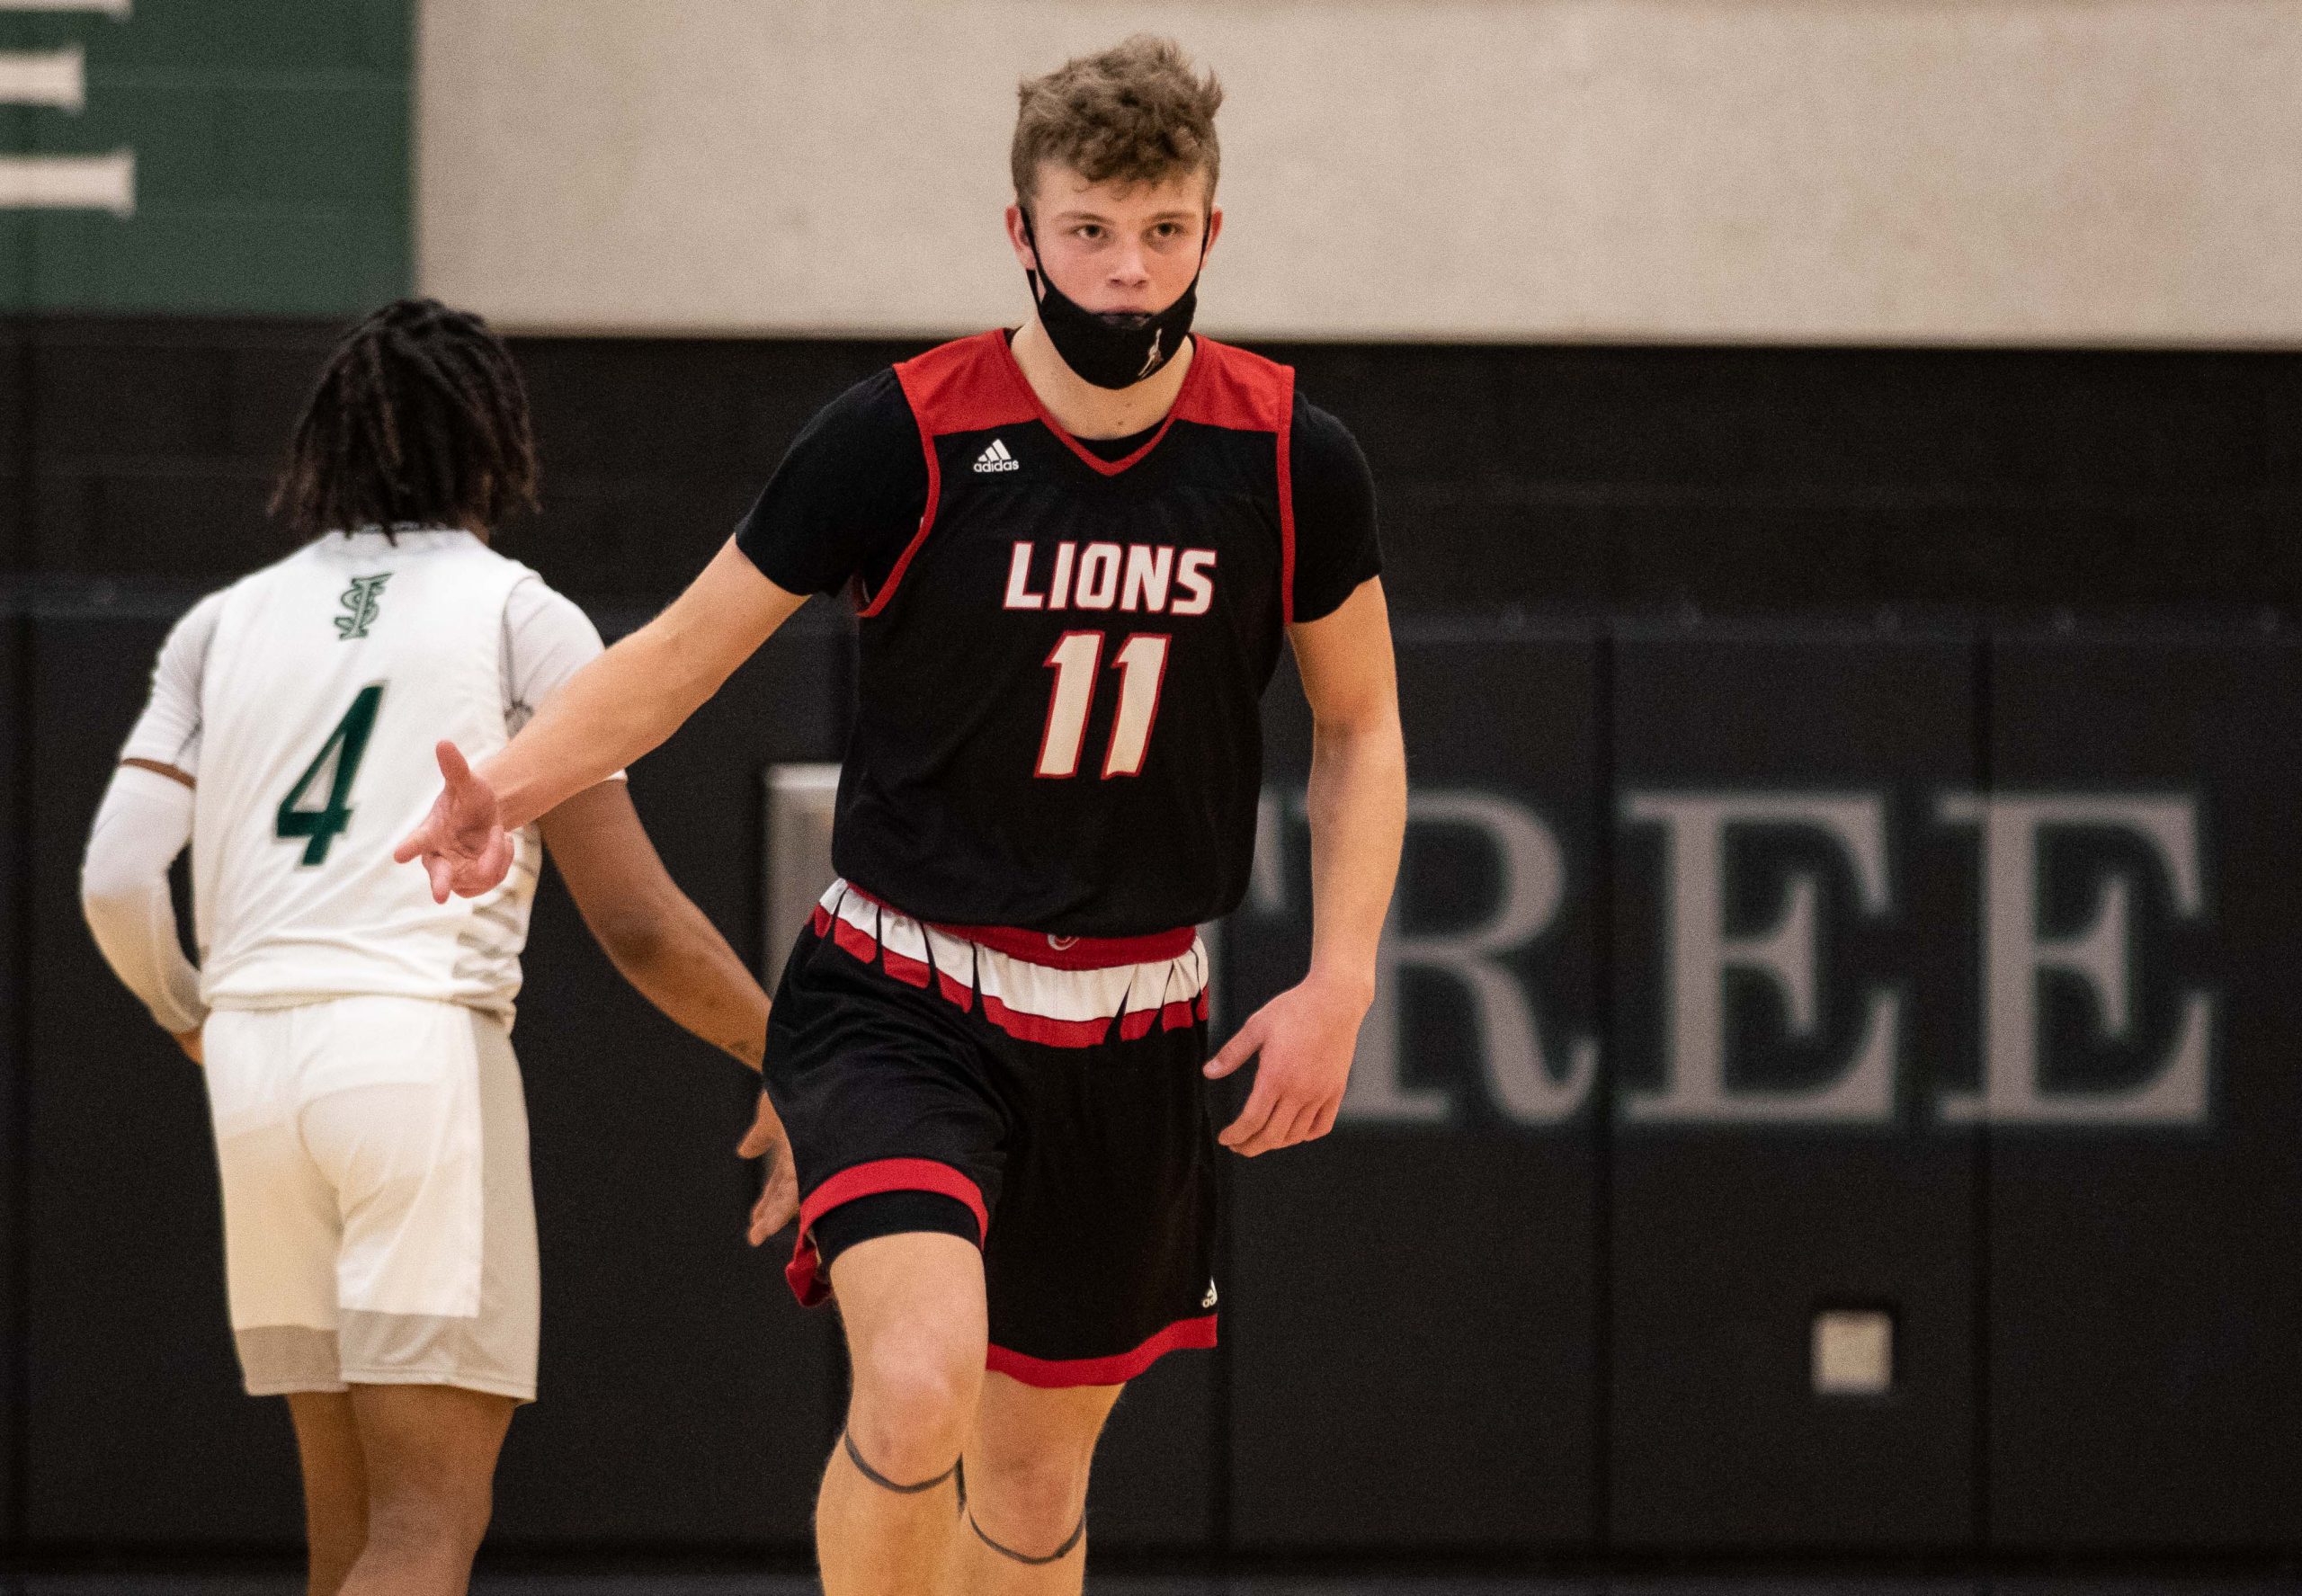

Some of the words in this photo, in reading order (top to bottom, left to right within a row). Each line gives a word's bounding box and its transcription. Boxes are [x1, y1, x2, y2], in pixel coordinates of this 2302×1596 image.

[973, 459, 1020, 473] adidas
[1003, 541, 1218, 616] LIONS
[274, 681, 387, 869] 4
[1033, 630, 1172, 780] 11
[1209, 789, 2214, 1128] REE
